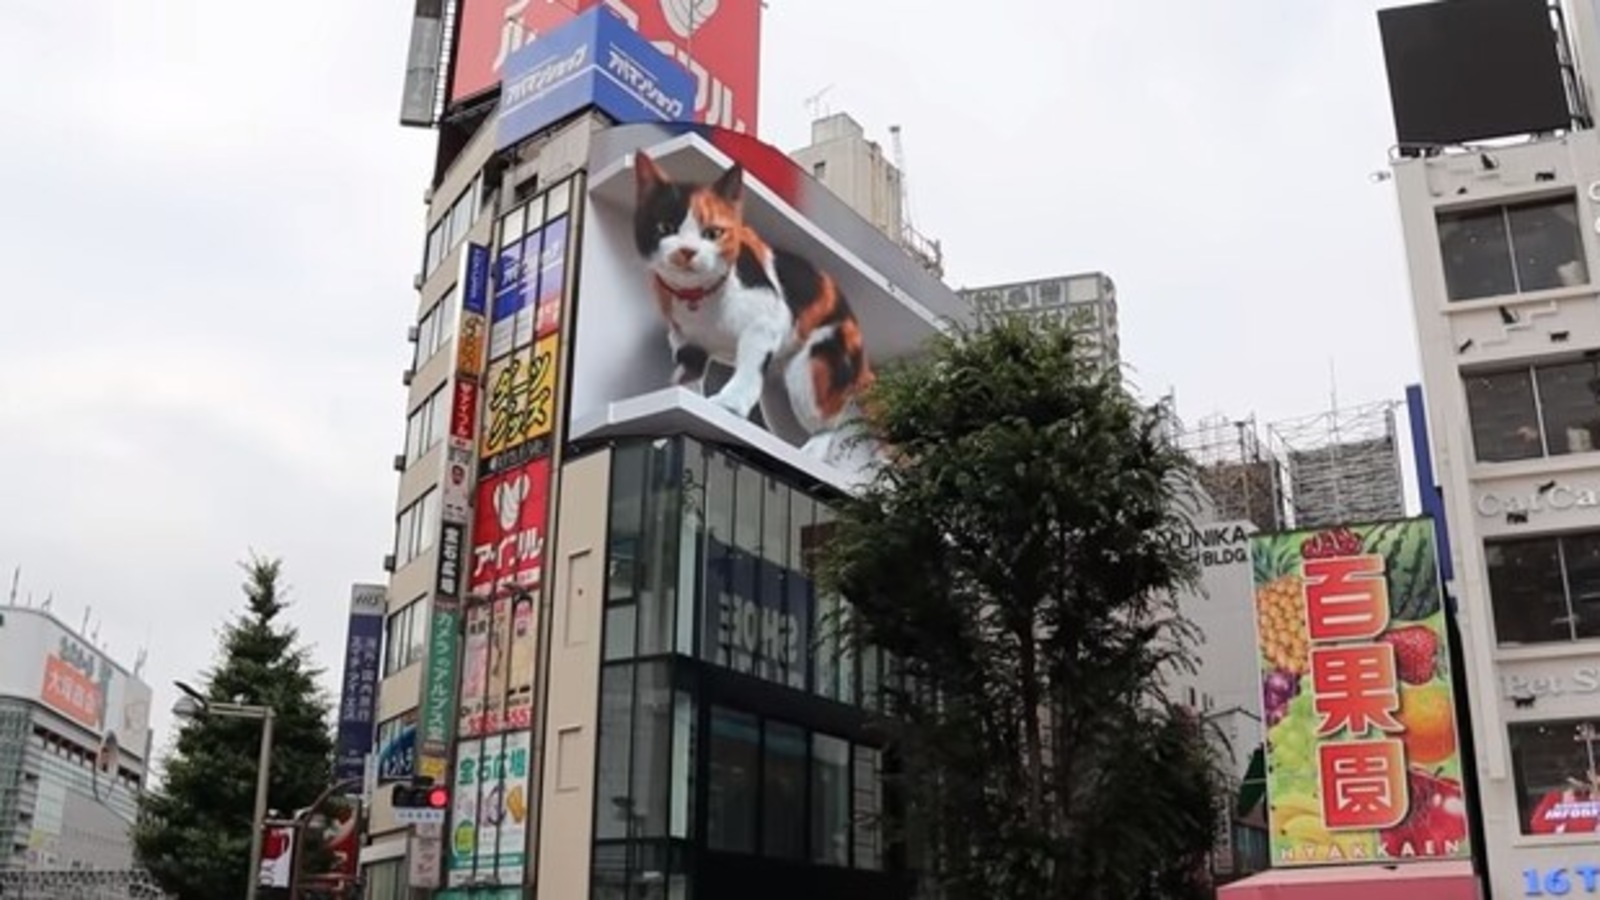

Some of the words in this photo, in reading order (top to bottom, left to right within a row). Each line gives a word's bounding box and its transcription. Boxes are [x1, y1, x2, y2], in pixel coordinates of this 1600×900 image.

[607, 49, 684, 119] アパマンショップ
[474, 526, 545, 578] アイフル
[1301, 555, 1409, 831] 百果園
[1521, 867, 1573, 897] 16
